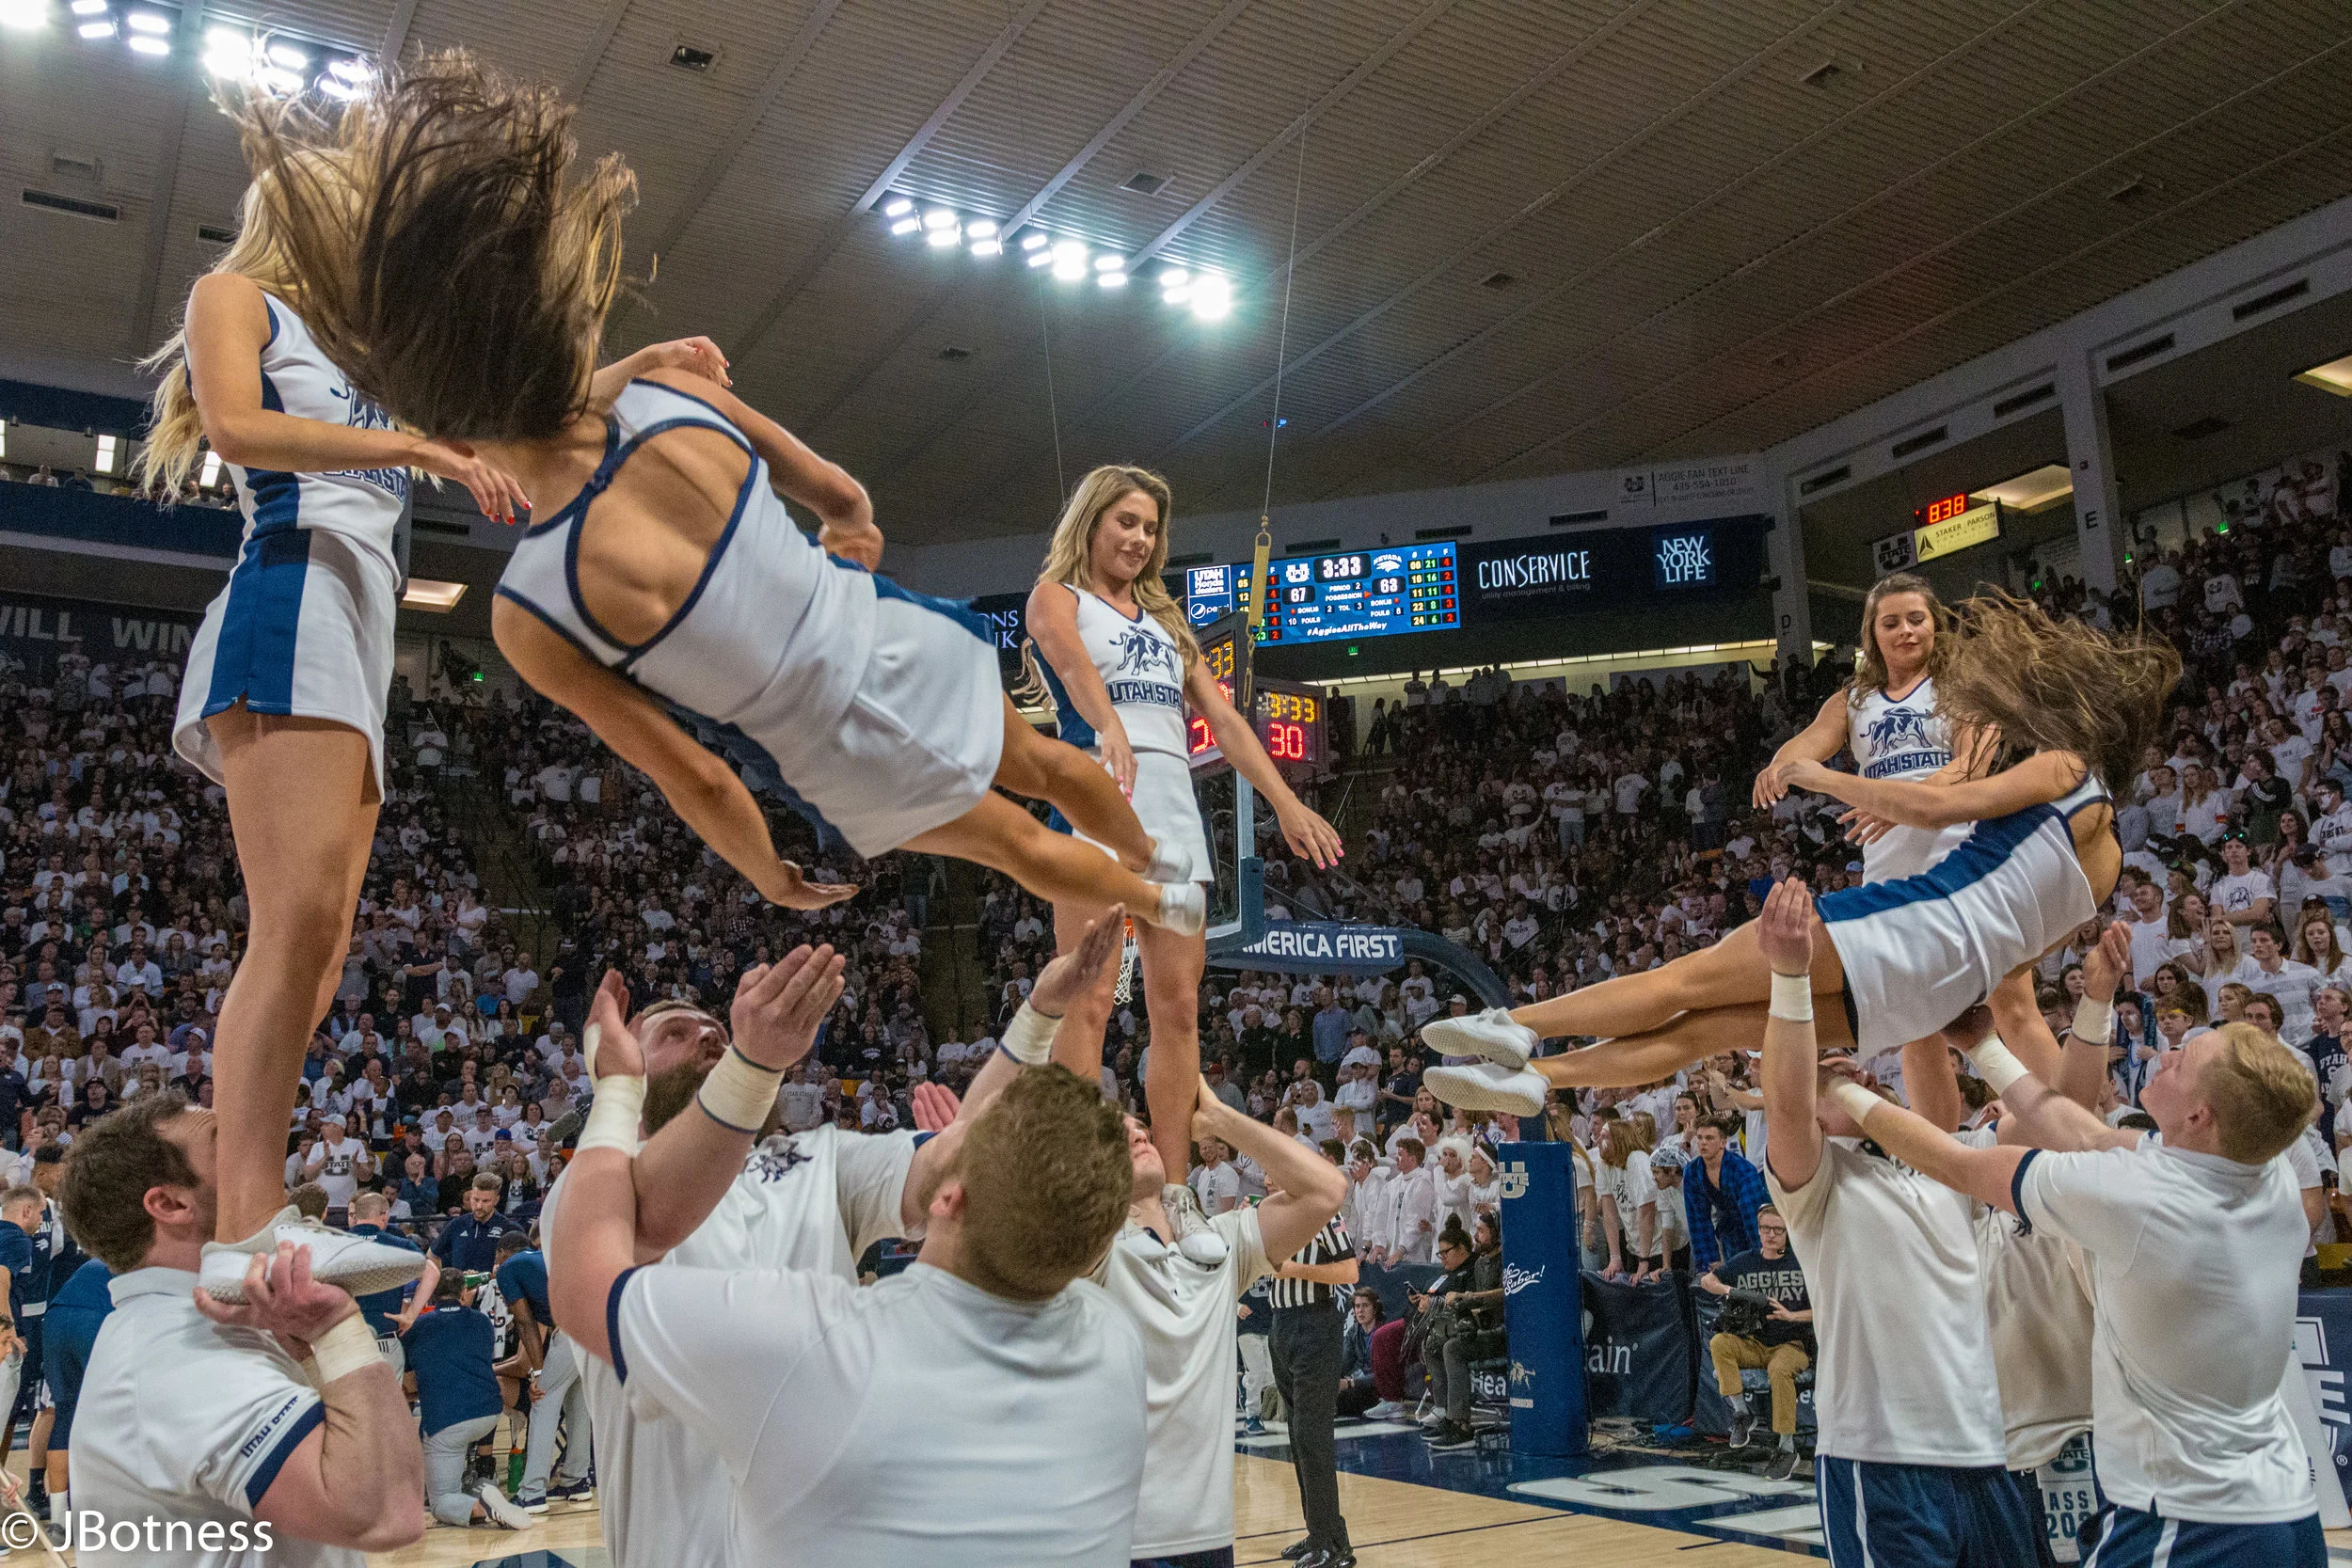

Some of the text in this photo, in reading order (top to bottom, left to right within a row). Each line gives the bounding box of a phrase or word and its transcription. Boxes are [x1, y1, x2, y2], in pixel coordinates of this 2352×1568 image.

[2085, 510, 2098, 530] E
[1935, 523, 1962, 538] STAKER
[1661, 535, 1705, 555] NEW
[1374, 553, 1402, 565] NEVADA
[1425, 560, 1436, 568] 21
[1443, 557, 1451, 566] 4
[1656, 548, 1711, 569] YORK
[1323, 556, 1361, 578] 3:33
[1665, 564, 1707, 583] LIFE
[1271, 575, 1277, 584] 1
[1426, 573, 1438, 581] 16
[1445, 571, 1451, 580] 2
[1329, 584, 1351, 593] PERIOD
[1412, 585, 1452, 598] 11 11 4
[1239, 589, 1277, 602] 12 4
[1326, 593, 1362, 602] POSSESSION
[1271, 603, 1278, 612] 4
[1357, 602, 1363, 610] 3
[1371, 598, 1392, 607] BONUS
[1412, 599, 1453, 611] 22 8 3
[1297, 606, 1319, 615] BONUS
[1371, 609, 1391, 617] FOULS
[1301, 616, 1321, 625] FOULS
[1413, 612, 1454, 626] 24 6 2
[1781, 614, 1791, 629] D
[1272, 629, 1279, 640] 2
[1307, 622, 1387, 637] #AggiesAllTheWay
[1108, 681, 1153, 706] UTAH
[1270, 693, 1315, 723] 3:33
[1270, 723, 1303, 759] 30
[1899, 752, 1952, 774] STATE
[1337, 934, 1398, 958] FIRST
[1737, 1270, 1804, 1291] AGGIES
